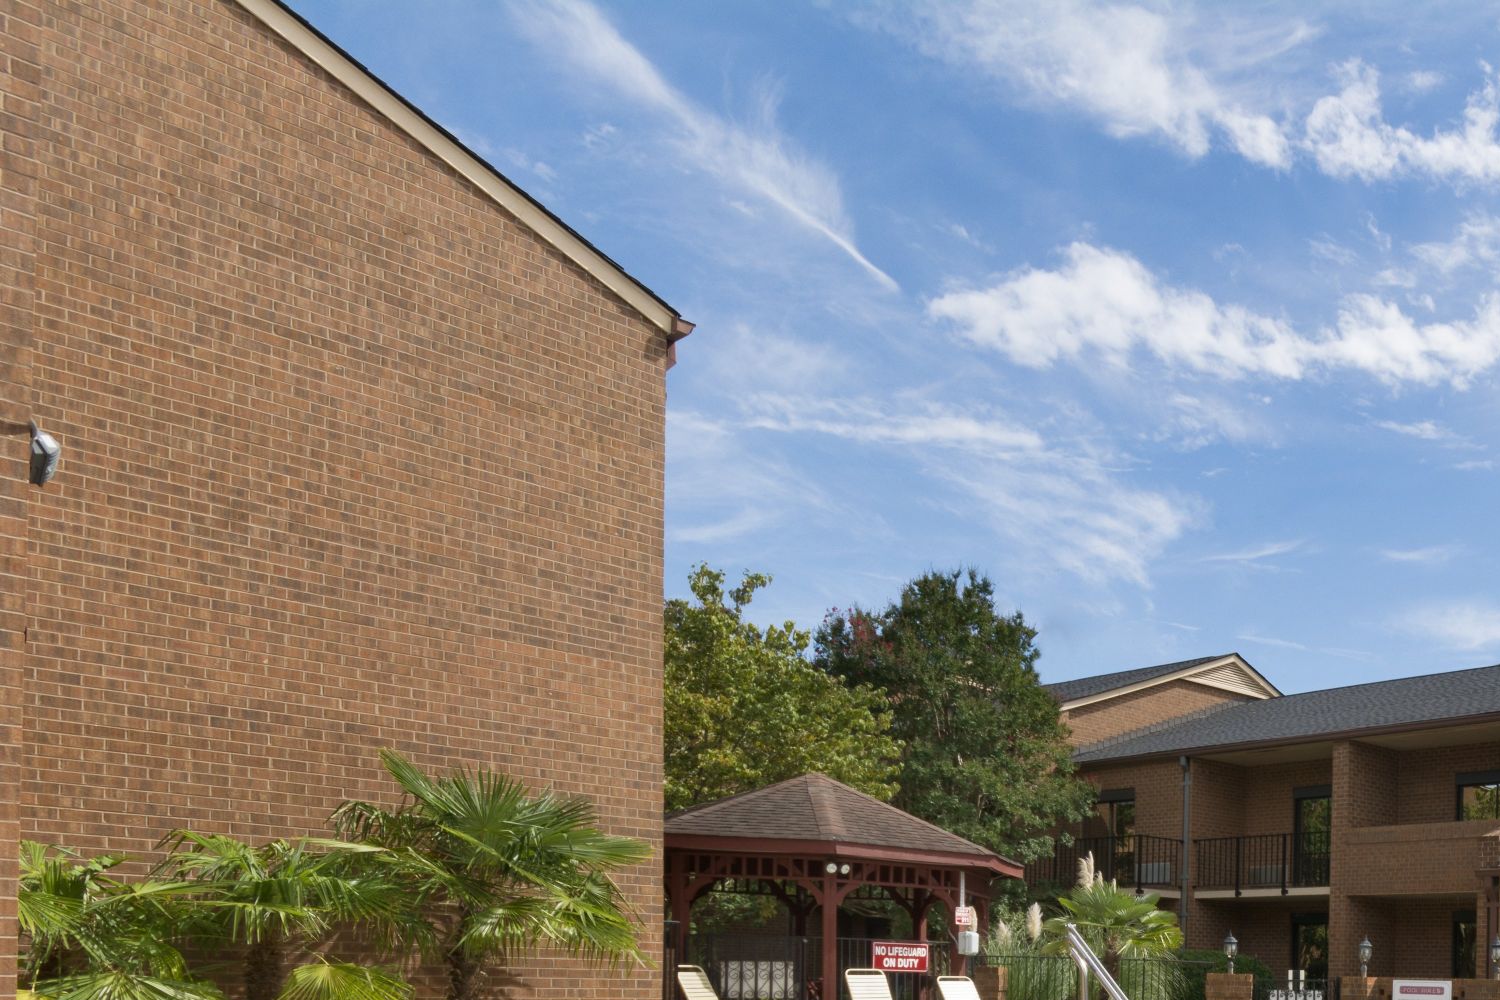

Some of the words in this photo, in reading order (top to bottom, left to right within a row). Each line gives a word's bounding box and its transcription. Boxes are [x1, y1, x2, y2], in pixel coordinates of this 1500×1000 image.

[875, 946, 887, 956] NO
[888, 946, 927, 957] LIFEGUARD
[883, 958, 896, 967] ON
[897, 959, 919, 968] DUTY
